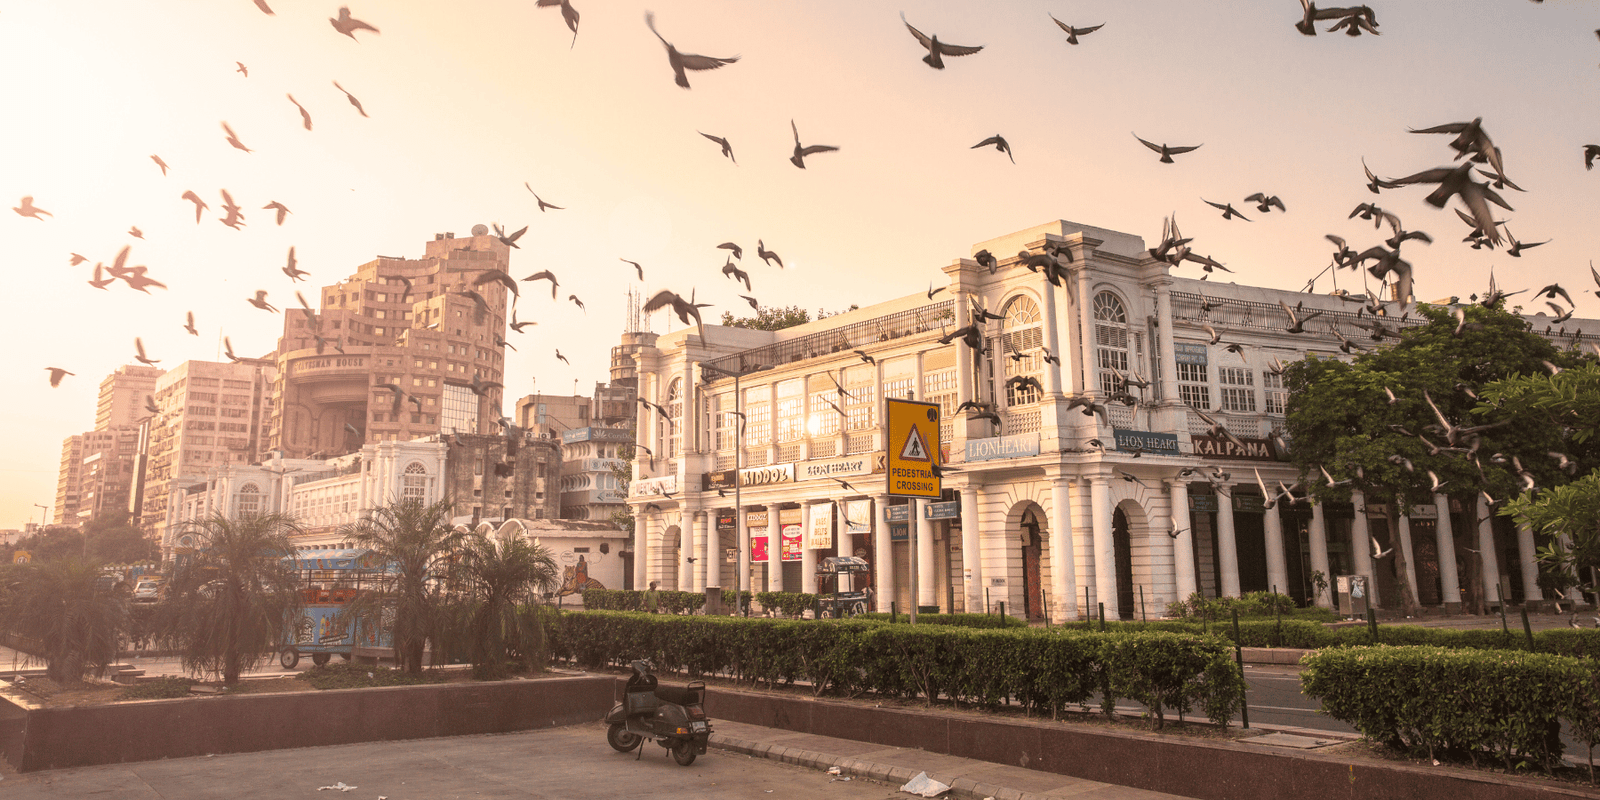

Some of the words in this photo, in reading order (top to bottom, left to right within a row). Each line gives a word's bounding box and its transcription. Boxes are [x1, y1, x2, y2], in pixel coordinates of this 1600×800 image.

[337, 358, 364, 367] HOUSE
[969, 437, 1034, 457] LIONHEART
[1119, 435, 1143, 448] LION
[1147, 438, 1176, 450] HEART
[1194, 440, 1270, 457] KALPANA
[743, 467, 788, 485] KIDDOZ
[807, 464, 829, 476] LION
[832, 461, 863, 474] HEART
[896, 481, 934, 491] CROSSING
